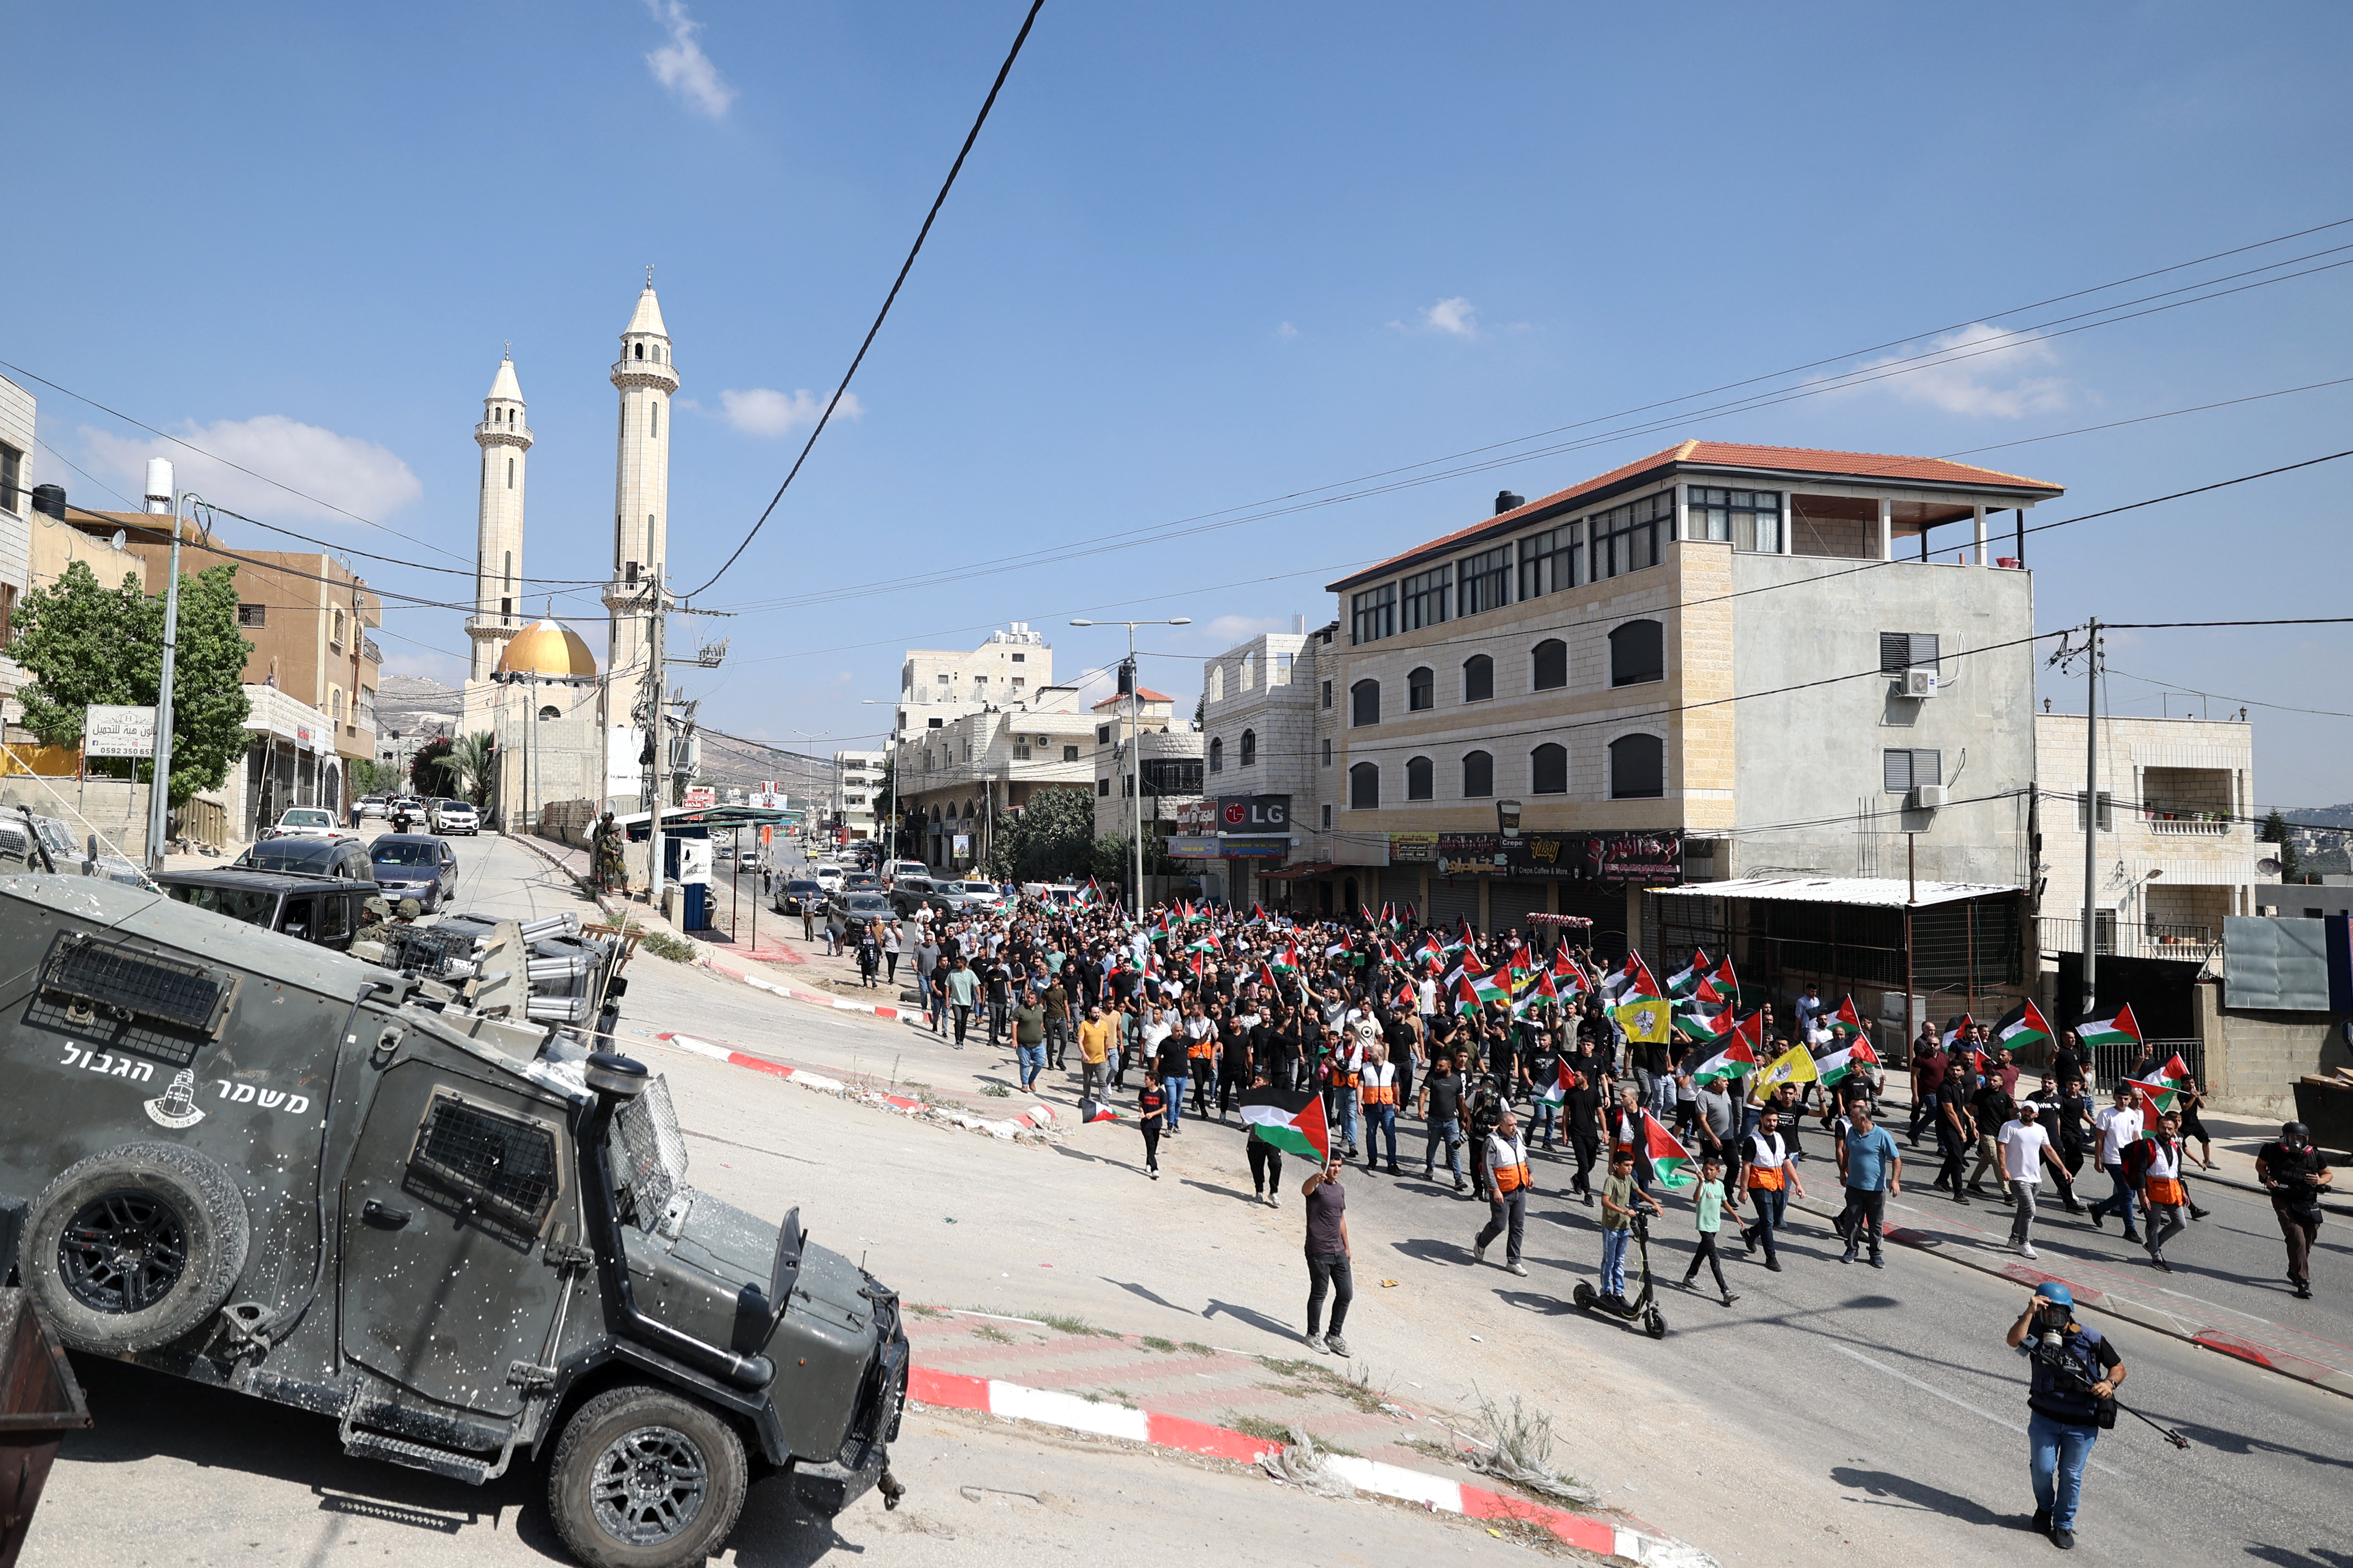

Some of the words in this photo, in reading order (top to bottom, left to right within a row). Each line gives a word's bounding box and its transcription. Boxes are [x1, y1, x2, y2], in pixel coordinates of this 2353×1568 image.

[93, 724, 120, 736] للتجميل
[123, 725, 137, 737] هبة
[1251, 805, 1284, 823] LG
[60, 1041, 154, 1083] הגבול
[217, 1079, 310, 1114] משמר
[148, 1105, 166, 1124] הגבול
[175, 1116, 197, 1126] משמר
